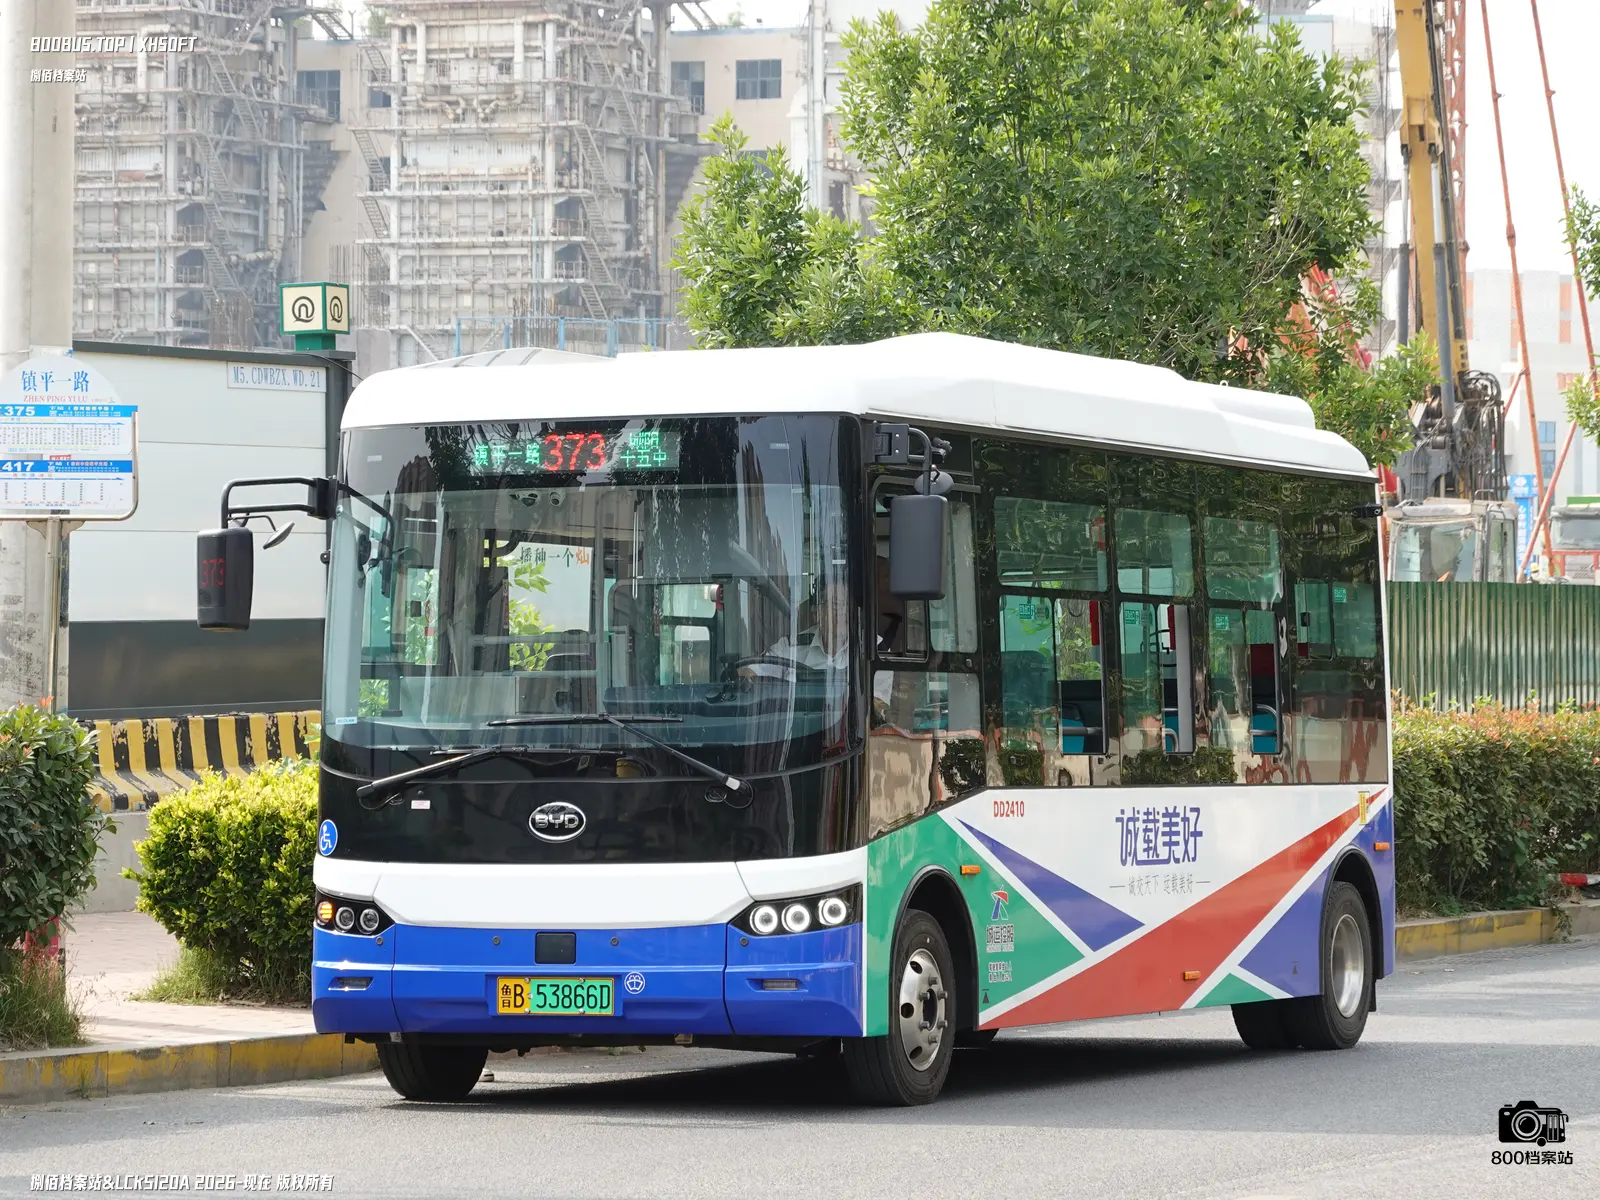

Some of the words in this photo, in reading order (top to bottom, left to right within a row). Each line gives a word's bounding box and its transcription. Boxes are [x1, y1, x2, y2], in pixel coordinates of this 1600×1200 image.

[21, 370, 89, 393] 镇平一路
[23, 395, 45, 403] ZHEN
[46, 395, 66, 403] PING
[4, 405, 35, 416] 375
[474, 442, 540, 466] 镇平一路
[543, 433, 606, 471] 373
[620, 448, 667, 467] 十五中
[2, 461, 35, 472] 417
[993, 799, 1026, 818] DD2410
[534, 814, 579, 829] BYD
[1115, 805, 1204, 867] 诚载美好
[501, 983, 525, 1009] 鲁B
[536, 983, 610, 1010] 53866D
